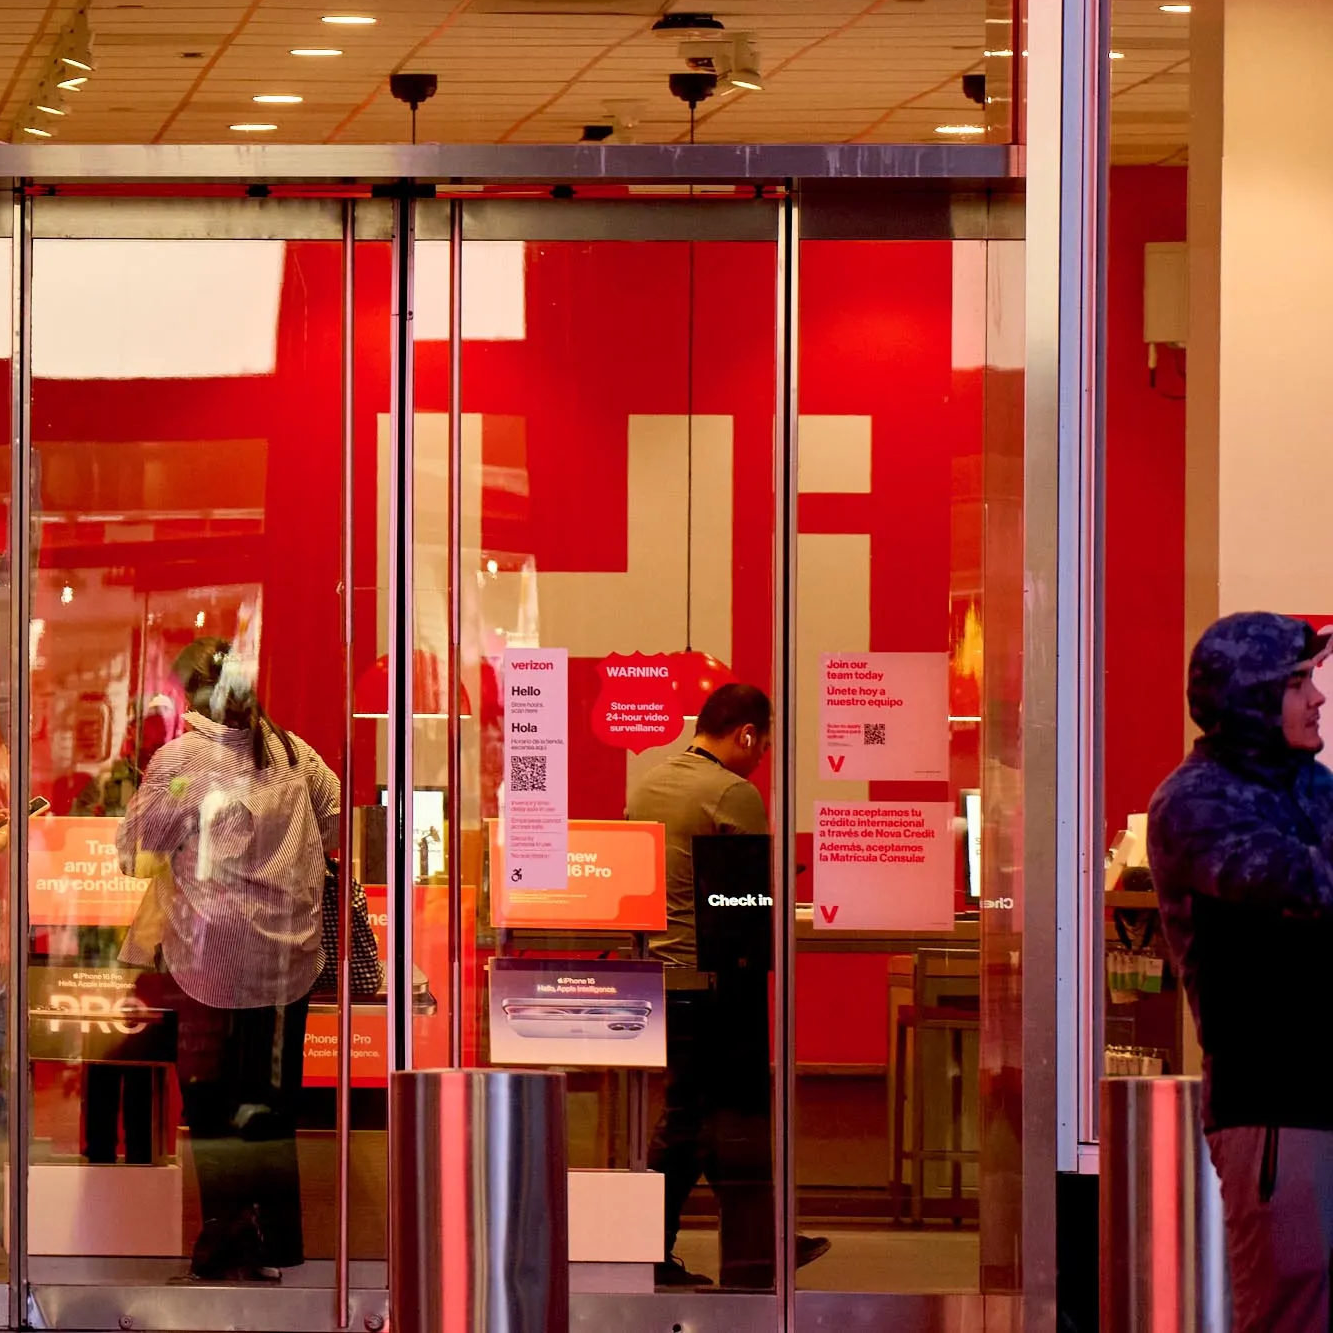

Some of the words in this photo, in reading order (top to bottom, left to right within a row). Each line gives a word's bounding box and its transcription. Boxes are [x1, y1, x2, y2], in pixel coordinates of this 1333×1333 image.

[511, 660, 554, 670] verizon
[827, 660, 849, 669] Join
[606, 666, 669, 677] WARNING
[827, 671, 853, 680] team
[855, 671, 884, 681] today
[511, 686, 541, 696] Hello
[827, 684, 858, 696] Únete
[859, 687, 878, 697] hoy
[879, 688, 886, 696] a
[610, 702, 636, 710] Store
[637, 702, 664, 710] under
[827, 698, 866, 706] nuestro
[868, 698, 903, 708] equipo
[605, 713, 643, 721] 24-hour
[644, 713, 669, 721] video
[511, 723, 537, 732] Hola
[610, 724, 665, 732] surveillance
[819, 808, 850, 816] Ahora
[852, 808, 910, 818] aceptamos
[911, 809, 922, 817] tu
[819, 818, 855, 827] crédito
[857, 818, 925, 828] internacional
[819, 830, 826, 838] a
[827, 829, 859, 838] través
[861, 829, 874, 838] de
[875, 829, 901, 838] Nova
[903, 830, 935, 838] Credit
[85, 840, 118, 855] Tra
[819, 842, 864, 852] Además,
[865, 843, 923, 853] aceptamos
[819, 853, 828, 862] la
[830, 853, 878, 862] Matrícula
[879, 854, 925, 863] Consular
[64, 861, 98, 876] any
[100, 858, 119, 876] ph
[584, 865, 612, 878] Pro
[36, 878, 70, 894] any
[71, 877, 149, 892] conditio
[707, 894, 758, 906] Check
[758, 894, 774, 906] in
[304, 1033, 338, 1044] Phone
[352, 1033, 372, 1044] Pro
